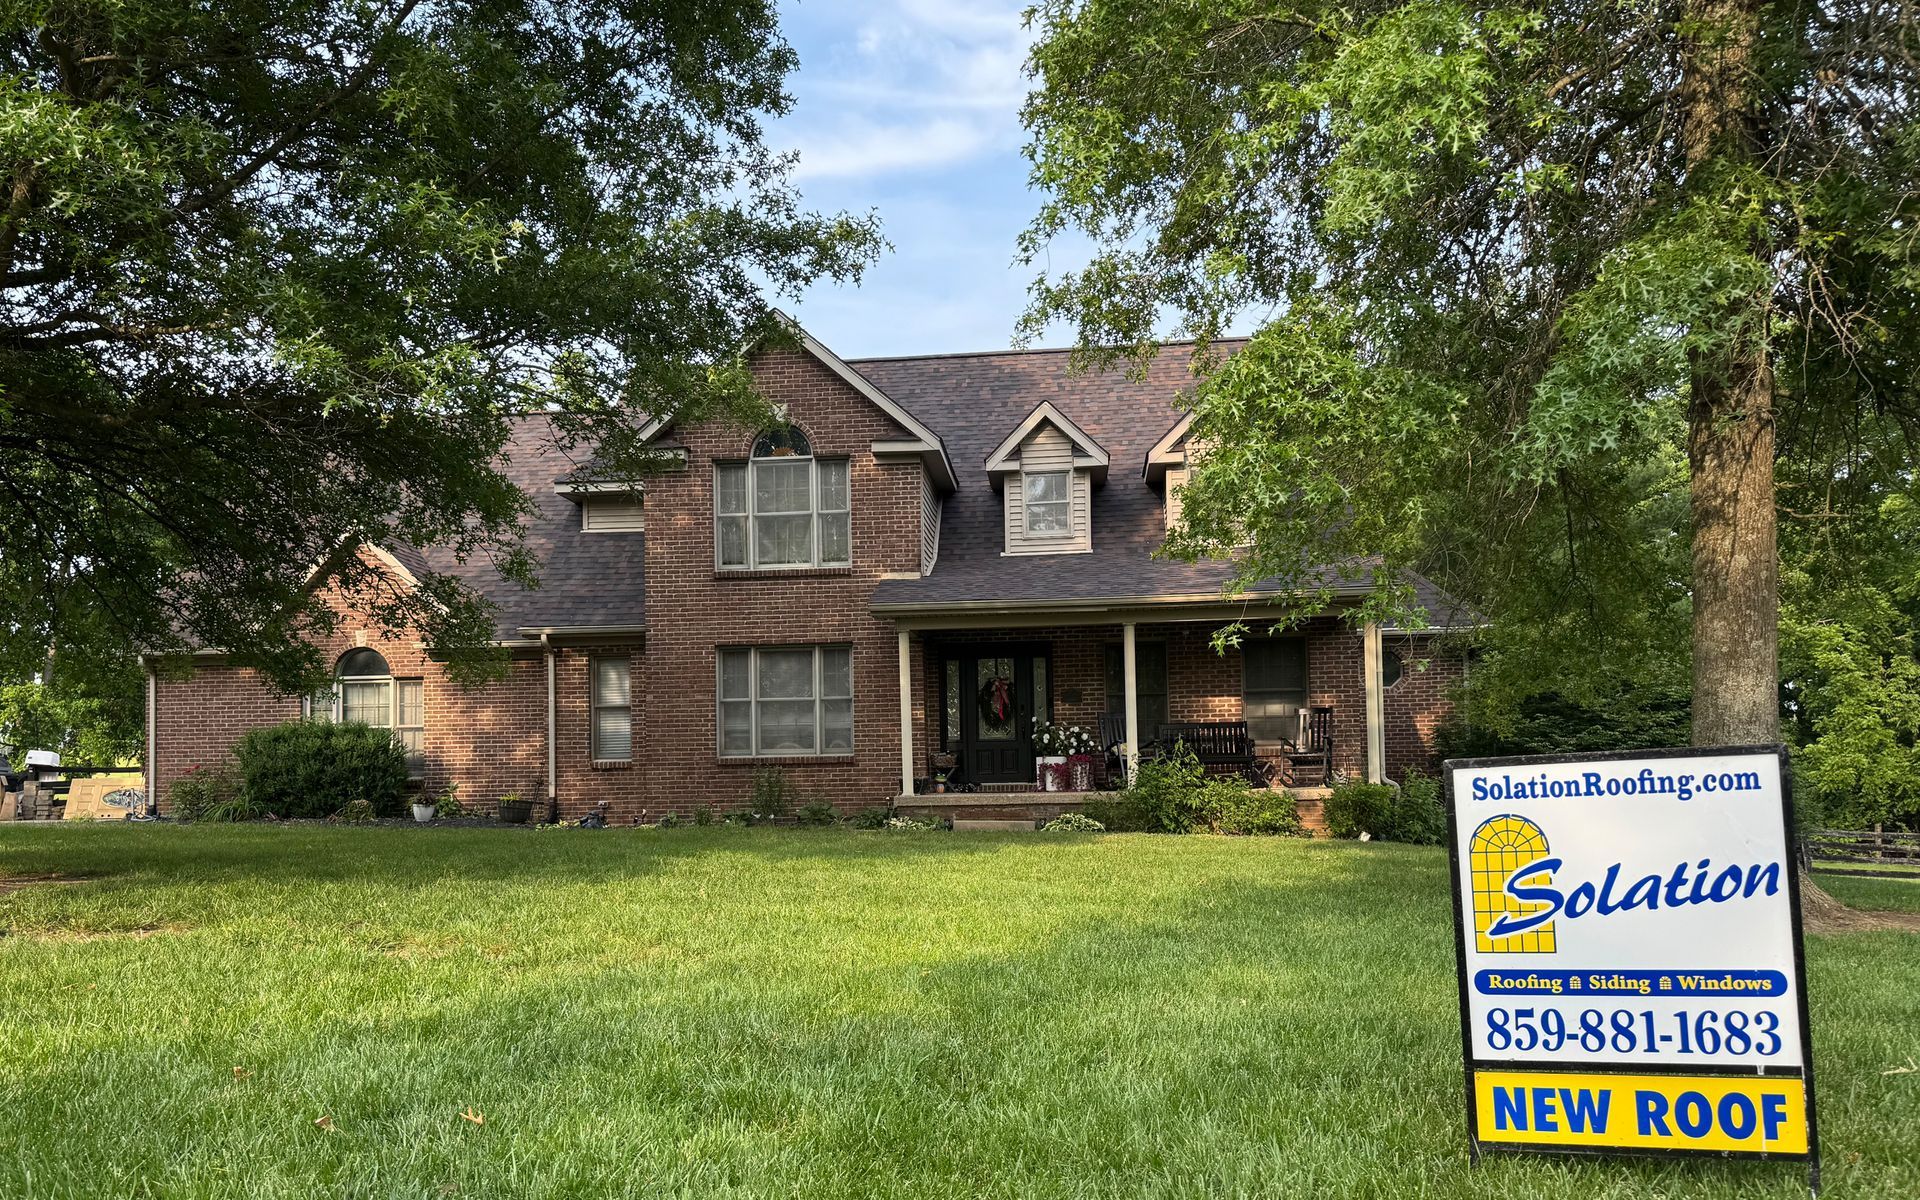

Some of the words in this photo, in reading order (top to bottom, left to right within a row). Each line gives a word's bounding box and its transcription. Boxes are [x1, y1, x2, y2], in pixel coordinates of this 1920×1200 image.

[1472, 768, 1762, 801] SolationRoofing.com
[1488, 858, 1780, 936] Solation
[1488, 974, 1563, 994] Roofing
[1589, 974, 1651, 994] Siding
[1676, 974, 1772, 991] Windows
[1486, 1007, 1782, 1056] 859-881-1683
[1492, 1086, 1612, 1134] NEW
[1635, 1090, 1788, 1140] ROOF
